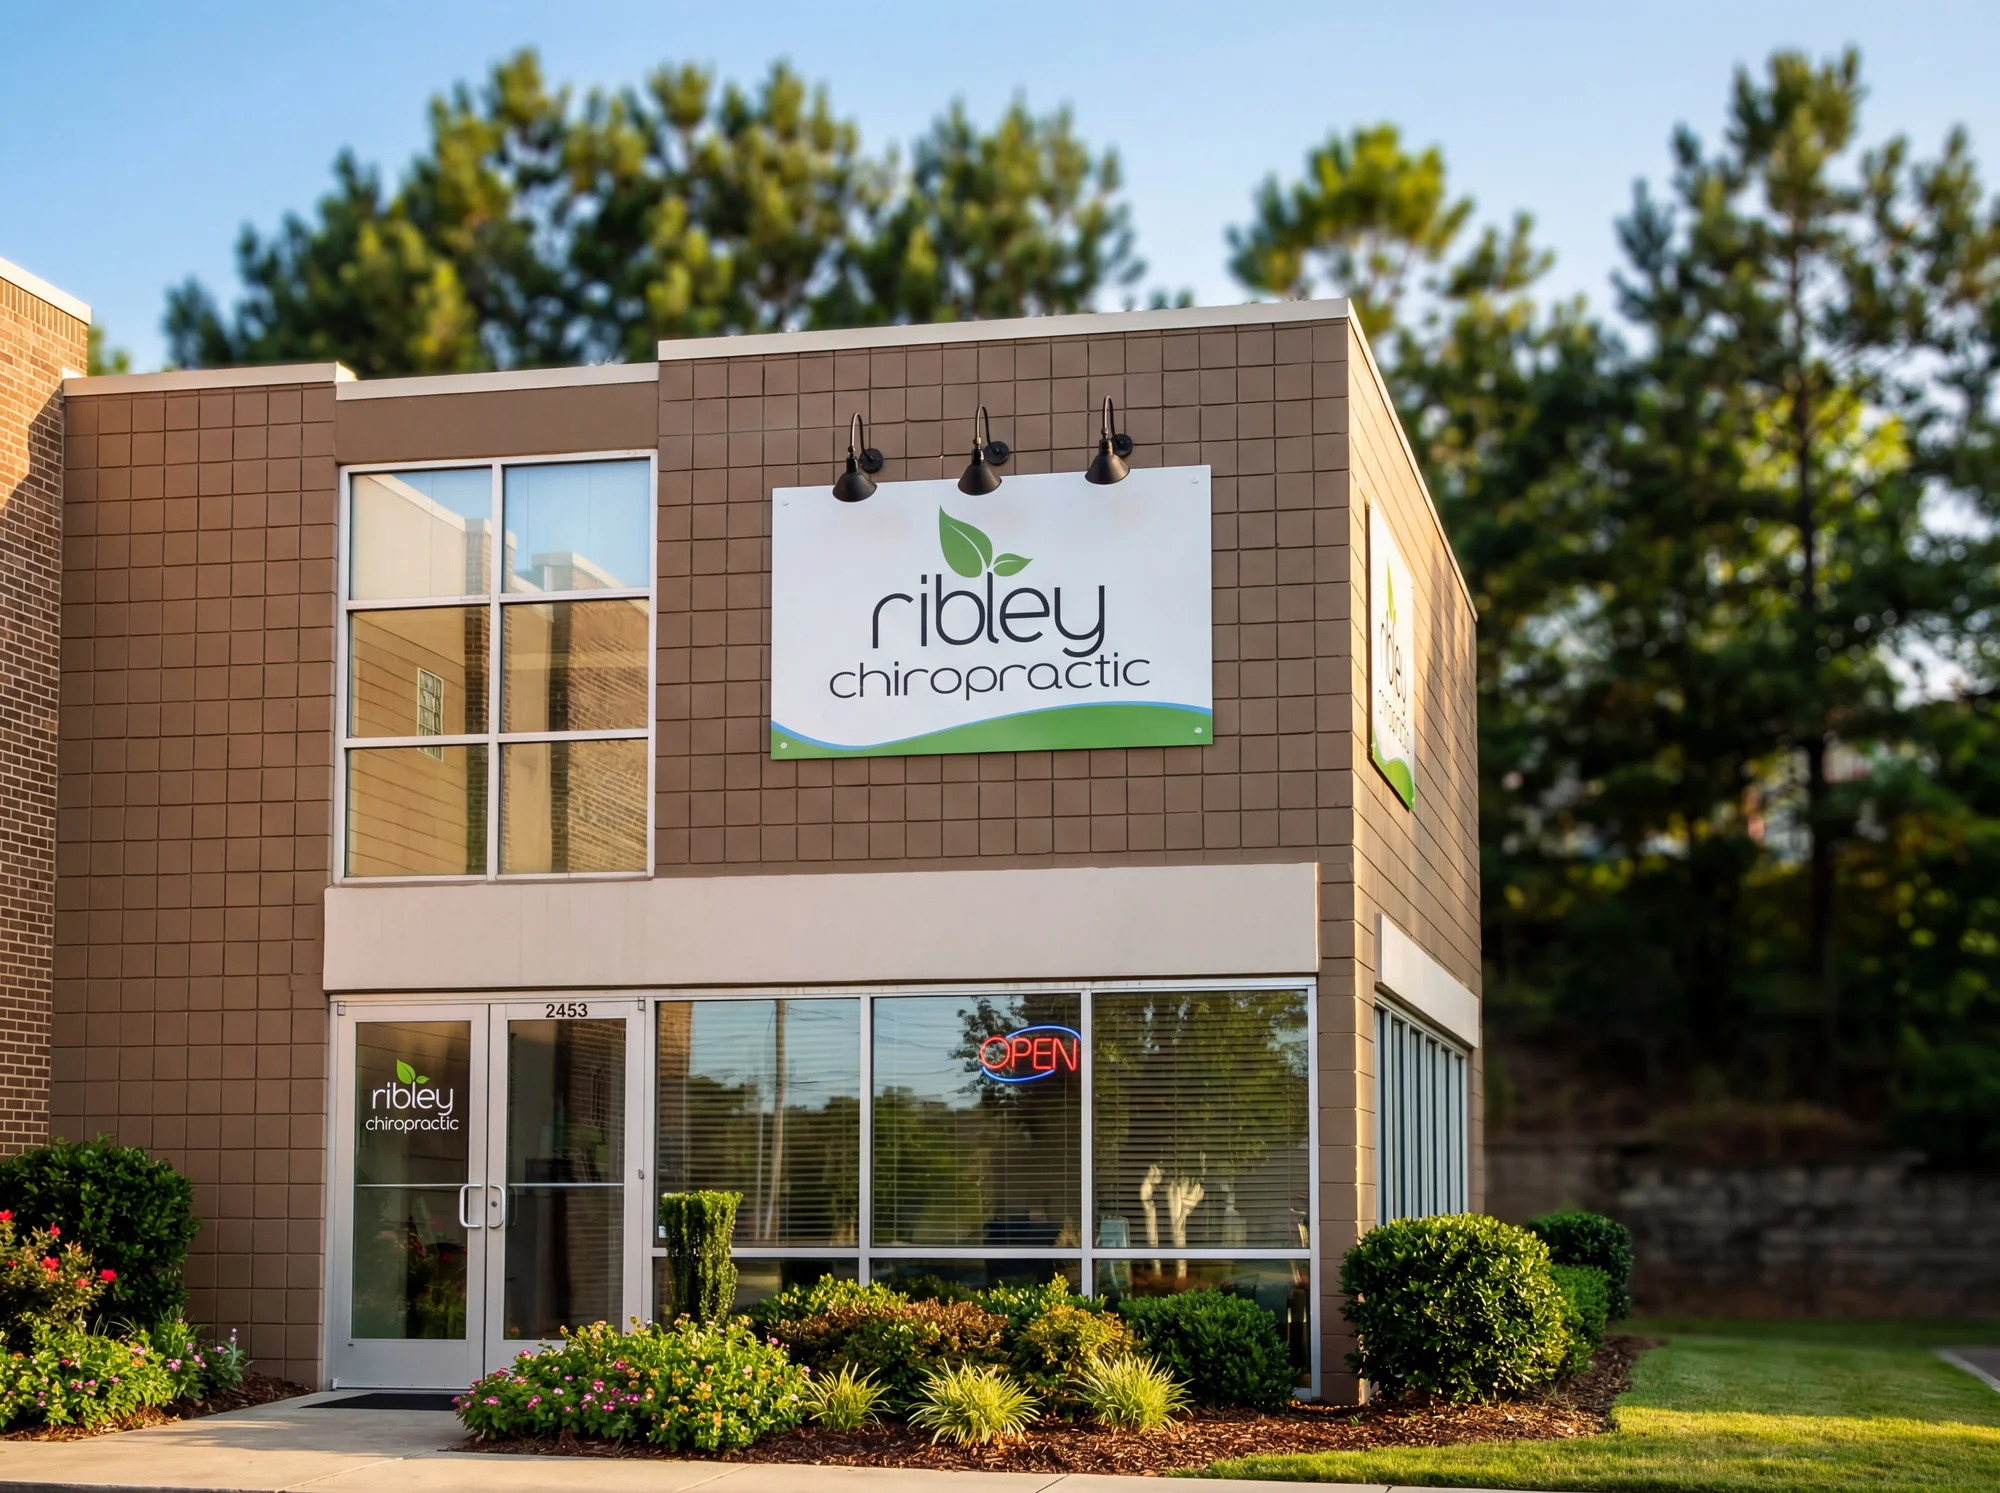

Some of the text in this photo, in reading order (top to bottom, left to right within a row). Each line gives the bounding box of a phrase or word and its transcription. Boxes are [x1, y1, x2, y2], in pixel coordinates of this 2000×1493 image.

[872, 572, 1105, 657] ribley
[829, 652, 1151, 700] chiropractic
[545, 1003, 588, 1018] 2453
[979, 1035, 1078, 1072] OPEN
[371, 1081, 454, 1116] ribley
[365, 1115, 459, 1134] chiropractic
